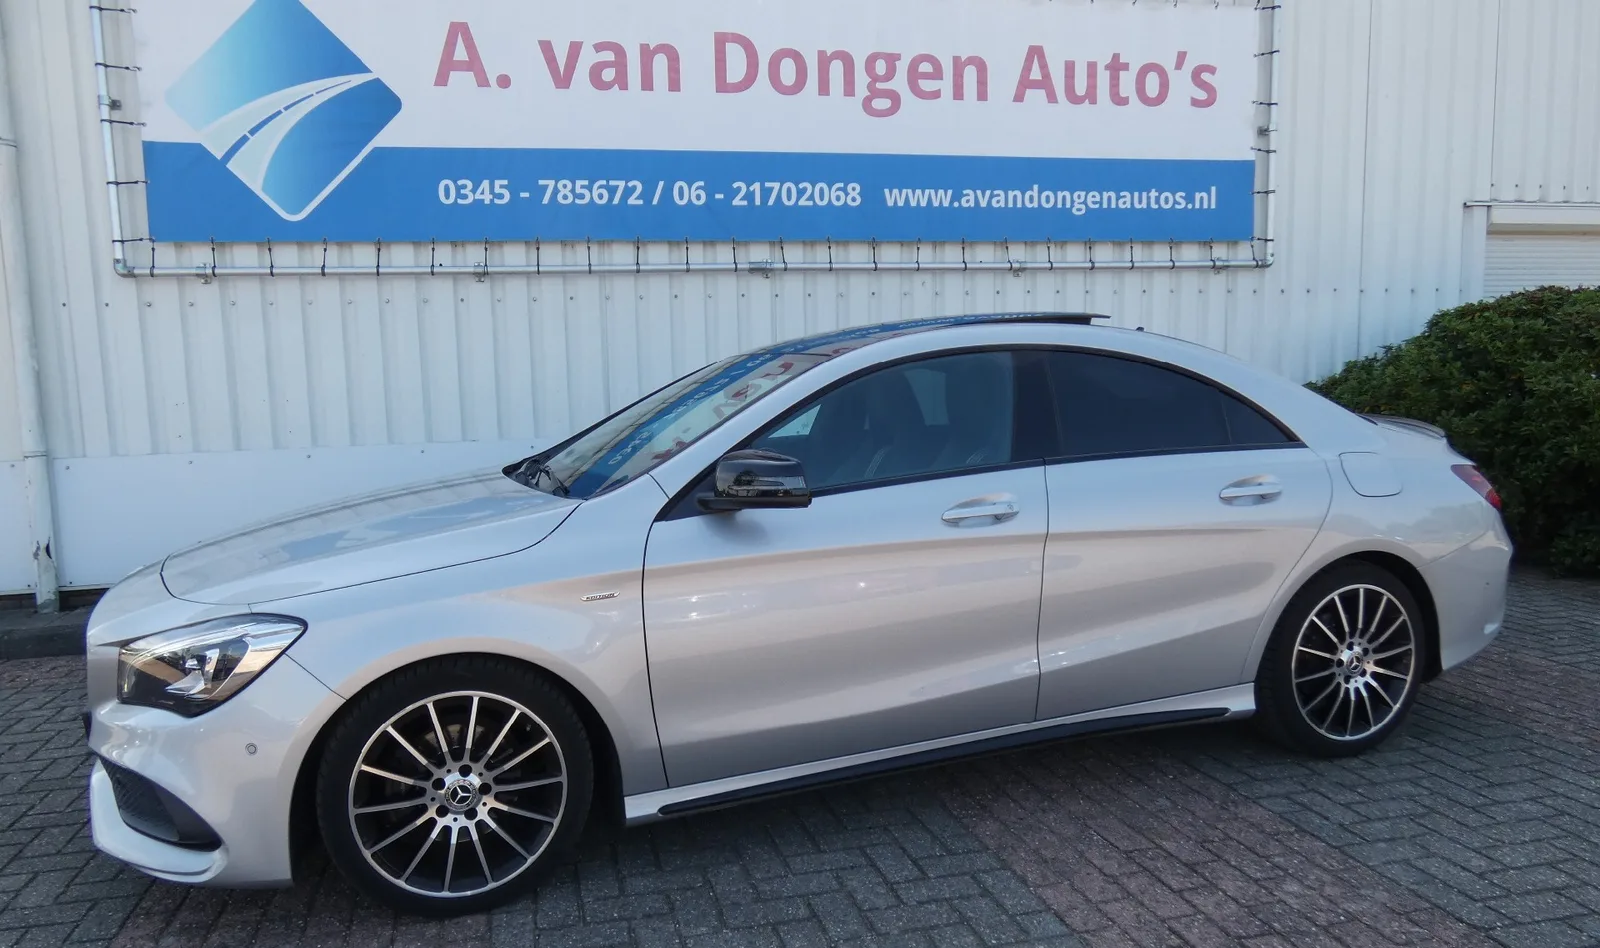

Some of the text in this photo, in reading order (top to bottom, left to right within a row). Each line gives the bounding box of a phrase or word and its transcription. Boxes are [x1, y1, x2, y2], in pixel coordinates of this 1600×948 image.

[434, 21, 512, 89] A.
[538, 39, 682, 92] van
[713, 31, 989, 117] Dongen
[438, 179, 510, 205] 0345
[538, 179, 644, 205] 785672
[672, 181, 707, 206] 06
[731, 181, 862, 206] 21702068
[883, 184, 1218, 215] www.avandongenautos.nl
